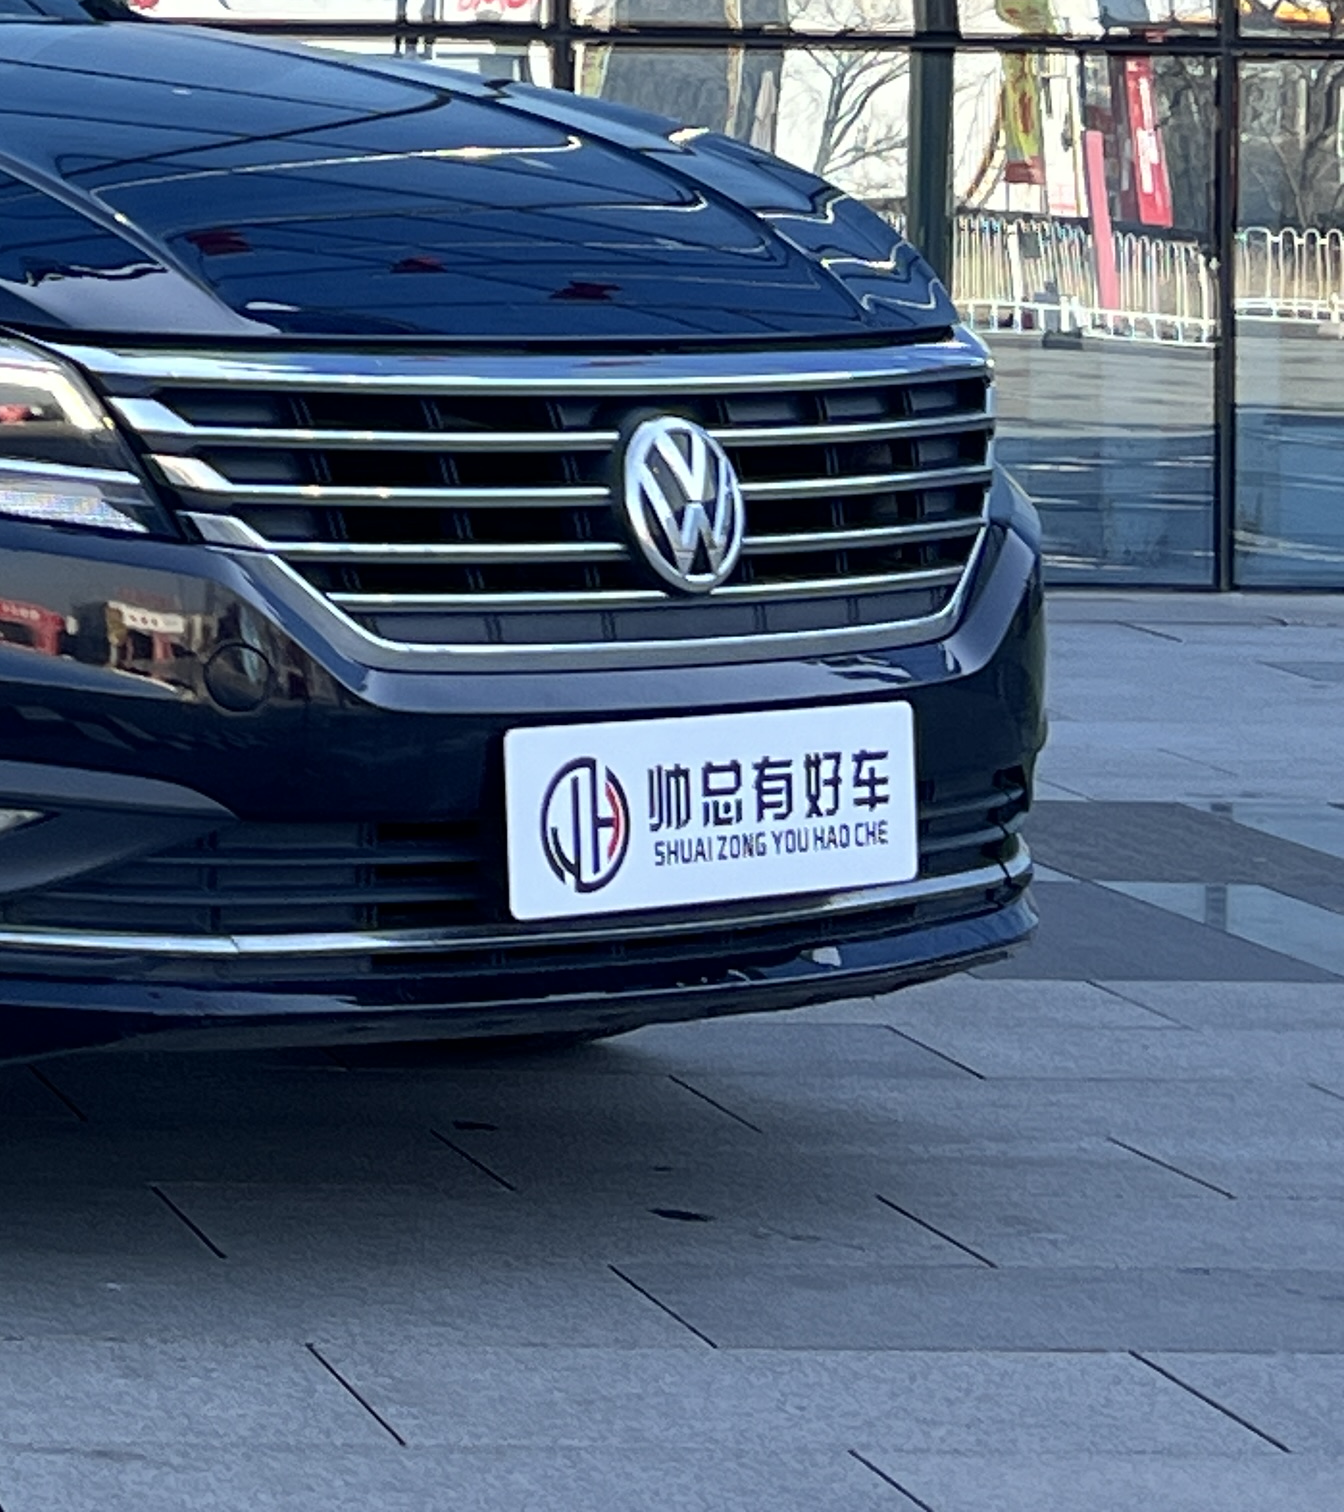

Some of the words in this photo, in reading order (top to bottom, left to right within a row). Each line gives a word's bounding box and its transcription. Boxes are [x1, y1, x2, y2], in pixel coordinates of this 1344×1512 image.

[648, 749, 889, 831] 帅总有好车
[654, 838, 713, 867] SHUAI
[717, 831, 767, 861] ZONG
[771, 827, 809, 856] YOU
[813, 823, 851, 851] HAO
[854, 820, 889, 847] CHE
